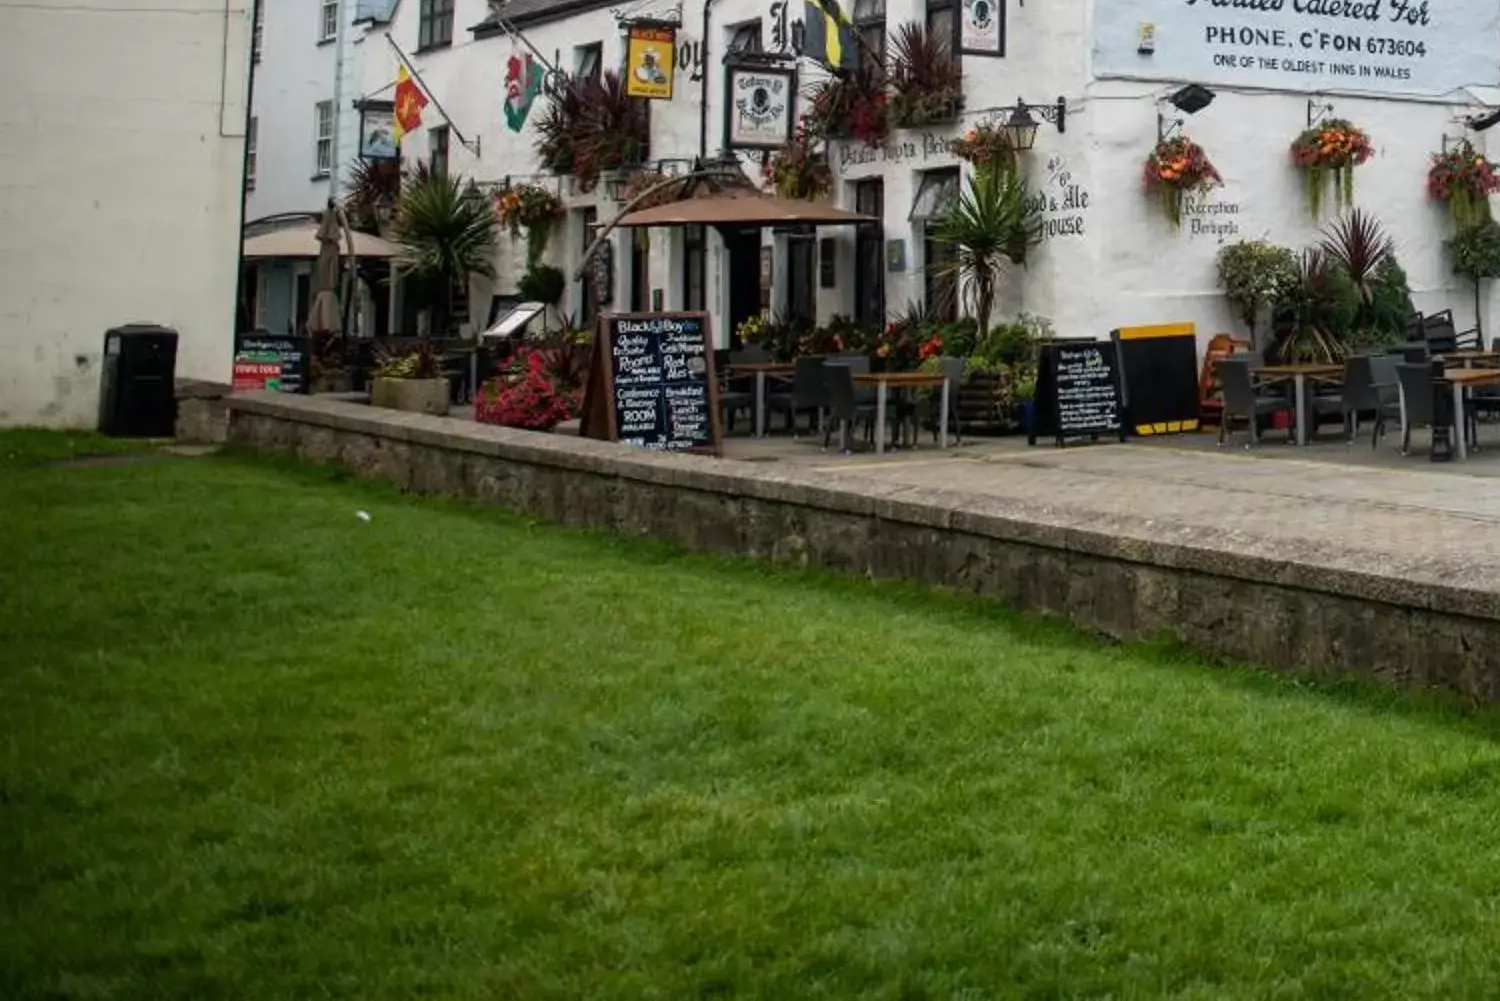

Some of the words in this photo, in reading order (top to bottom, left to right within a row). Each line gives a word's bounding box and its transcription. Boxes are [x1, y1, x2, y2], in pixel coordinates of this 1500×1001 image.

[1367, 37, 1427, 57] 673604
[1213, 54, 1237, 67] ONE
[1240, 56, 1255, 68] OF
[1259, 57, 1279, 70] THE
[1282, 59, 1325, 73] OLDEST
[1329, 62, 1356, 76] INNS
[1360, 65, 1371, 78] IN
[1374, 67, 1411, 80] WALES
[1059, 185, 1089, 211] Ale
[1183, 197, 1239, 216] Reception
[618, 320, 649, 334] Black
[663, 320, 683, 333] Boy
[622, 409, 656, 422] ROOM
